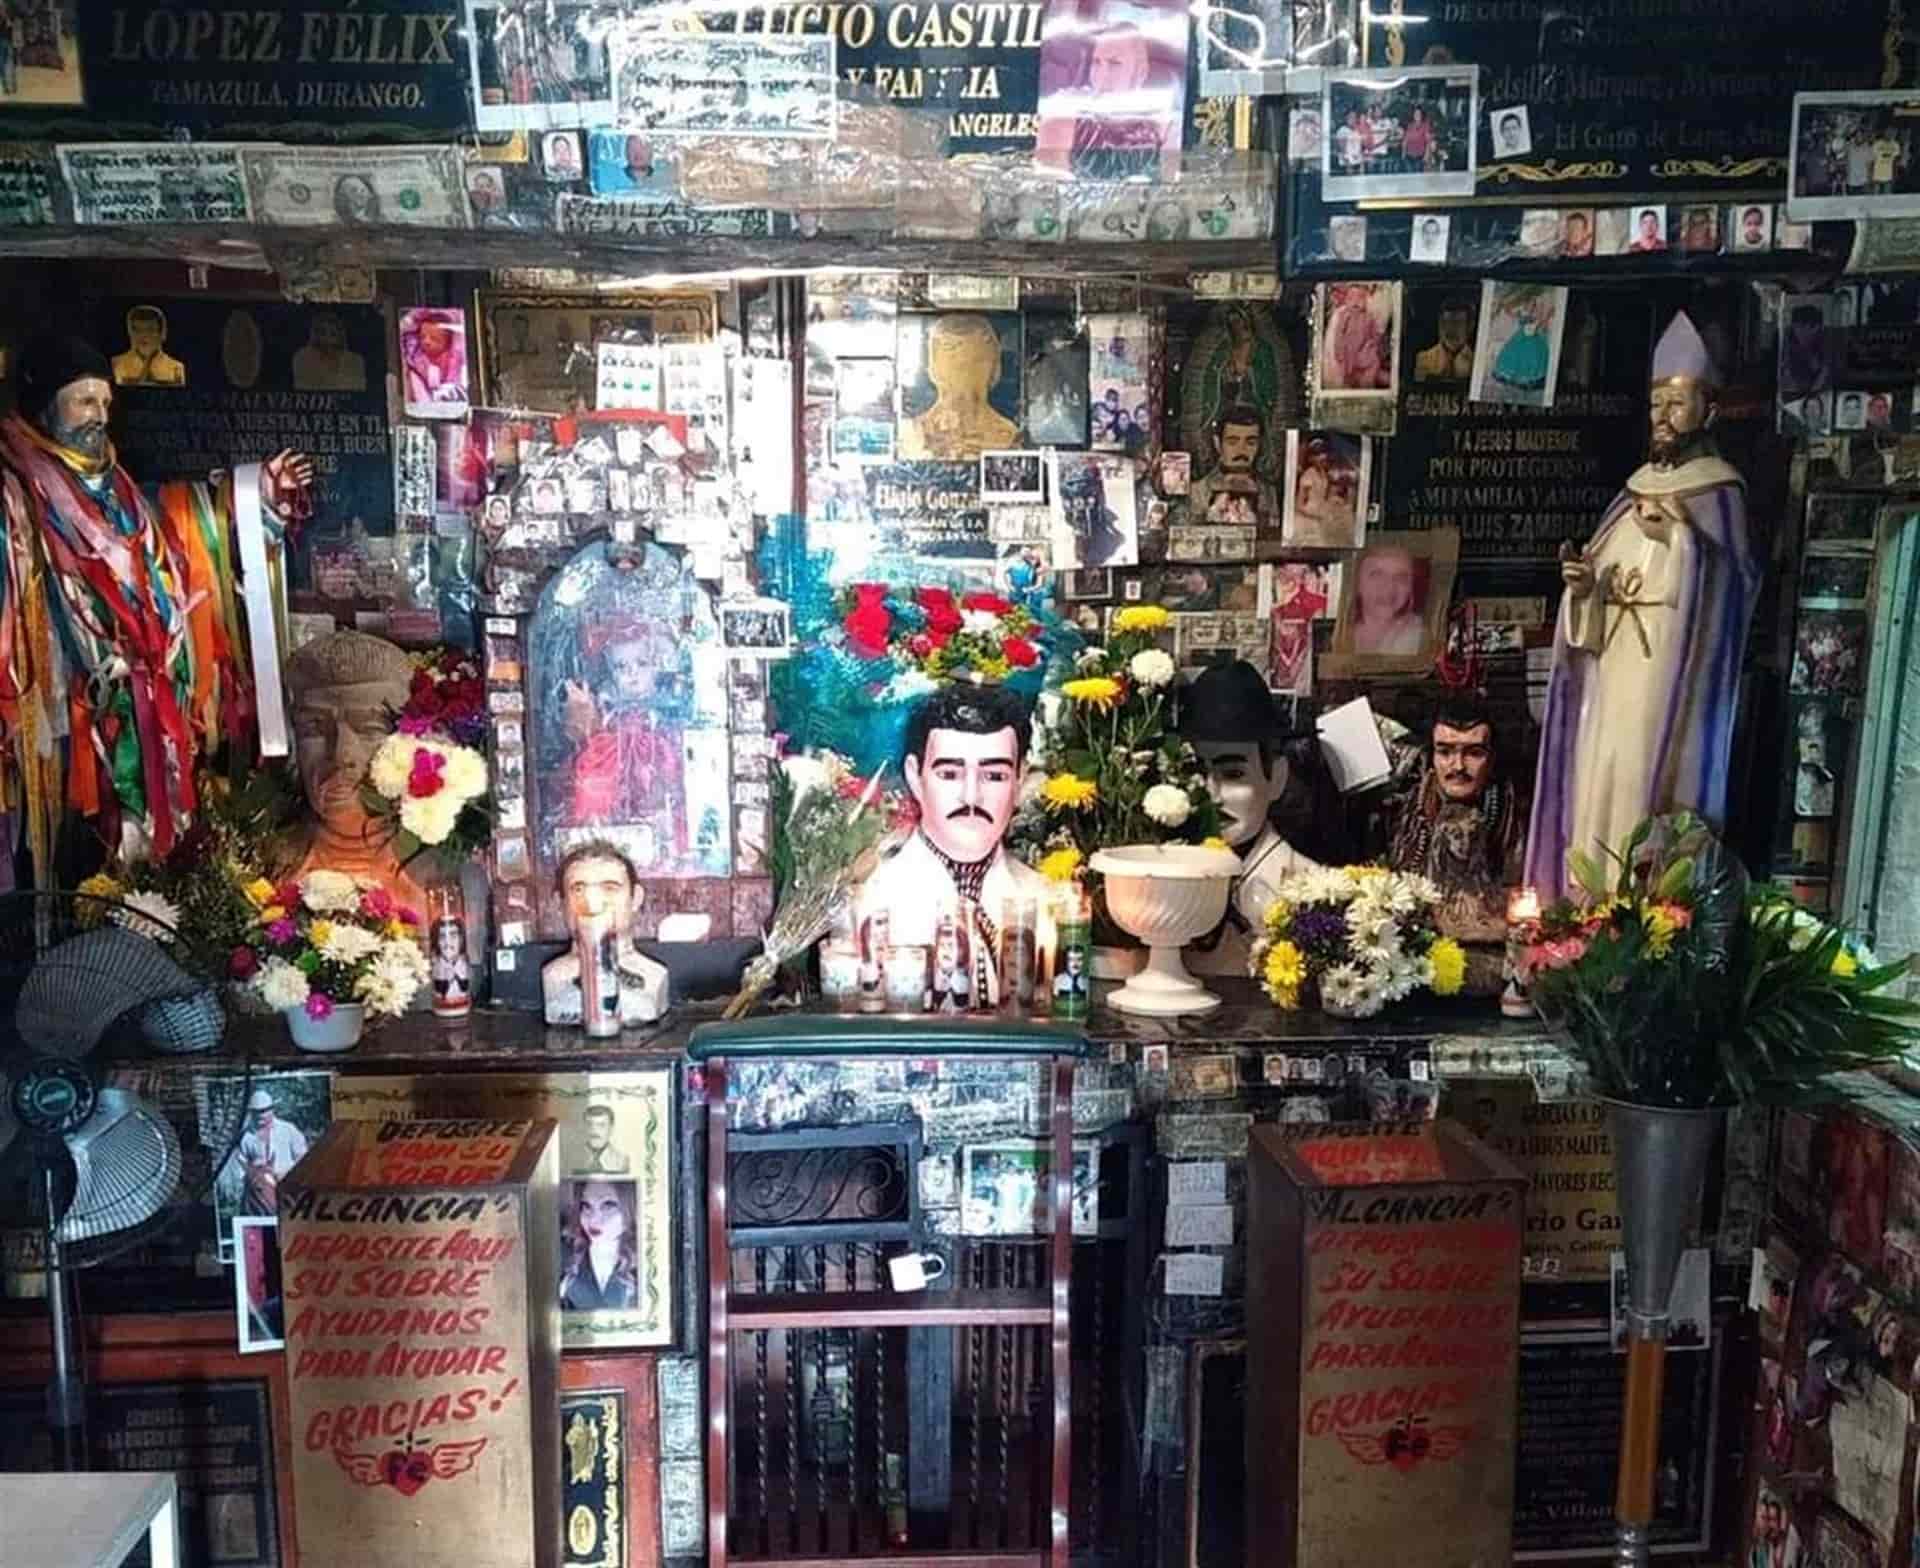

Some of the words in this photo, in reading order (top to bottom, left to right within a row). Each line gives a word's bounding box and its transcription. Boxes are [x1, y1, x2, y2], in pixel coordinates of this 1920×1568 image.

[297, 0, 456, 65] FÉLIX
[295, 82, 426, 109] DURANGO.
[1429, 457, 1466, 479] POR
[1462, 512, 1504, 539] LUIS
[377, 1119, 527, 1141] DEPOSITE
[284, 1231, 441, 1263] DEPOSITE
[286, 1269, 342, 1300] SU
[344, 1265, 491, 1299] SOBRE
[1319, 1261, 1376, 1294] SU
[288, 1305, 492, 1338] AYUDANOS
[293, 1348, 372, 1380] PARA
[374, 1341, 507, 1379] AYUDAR
